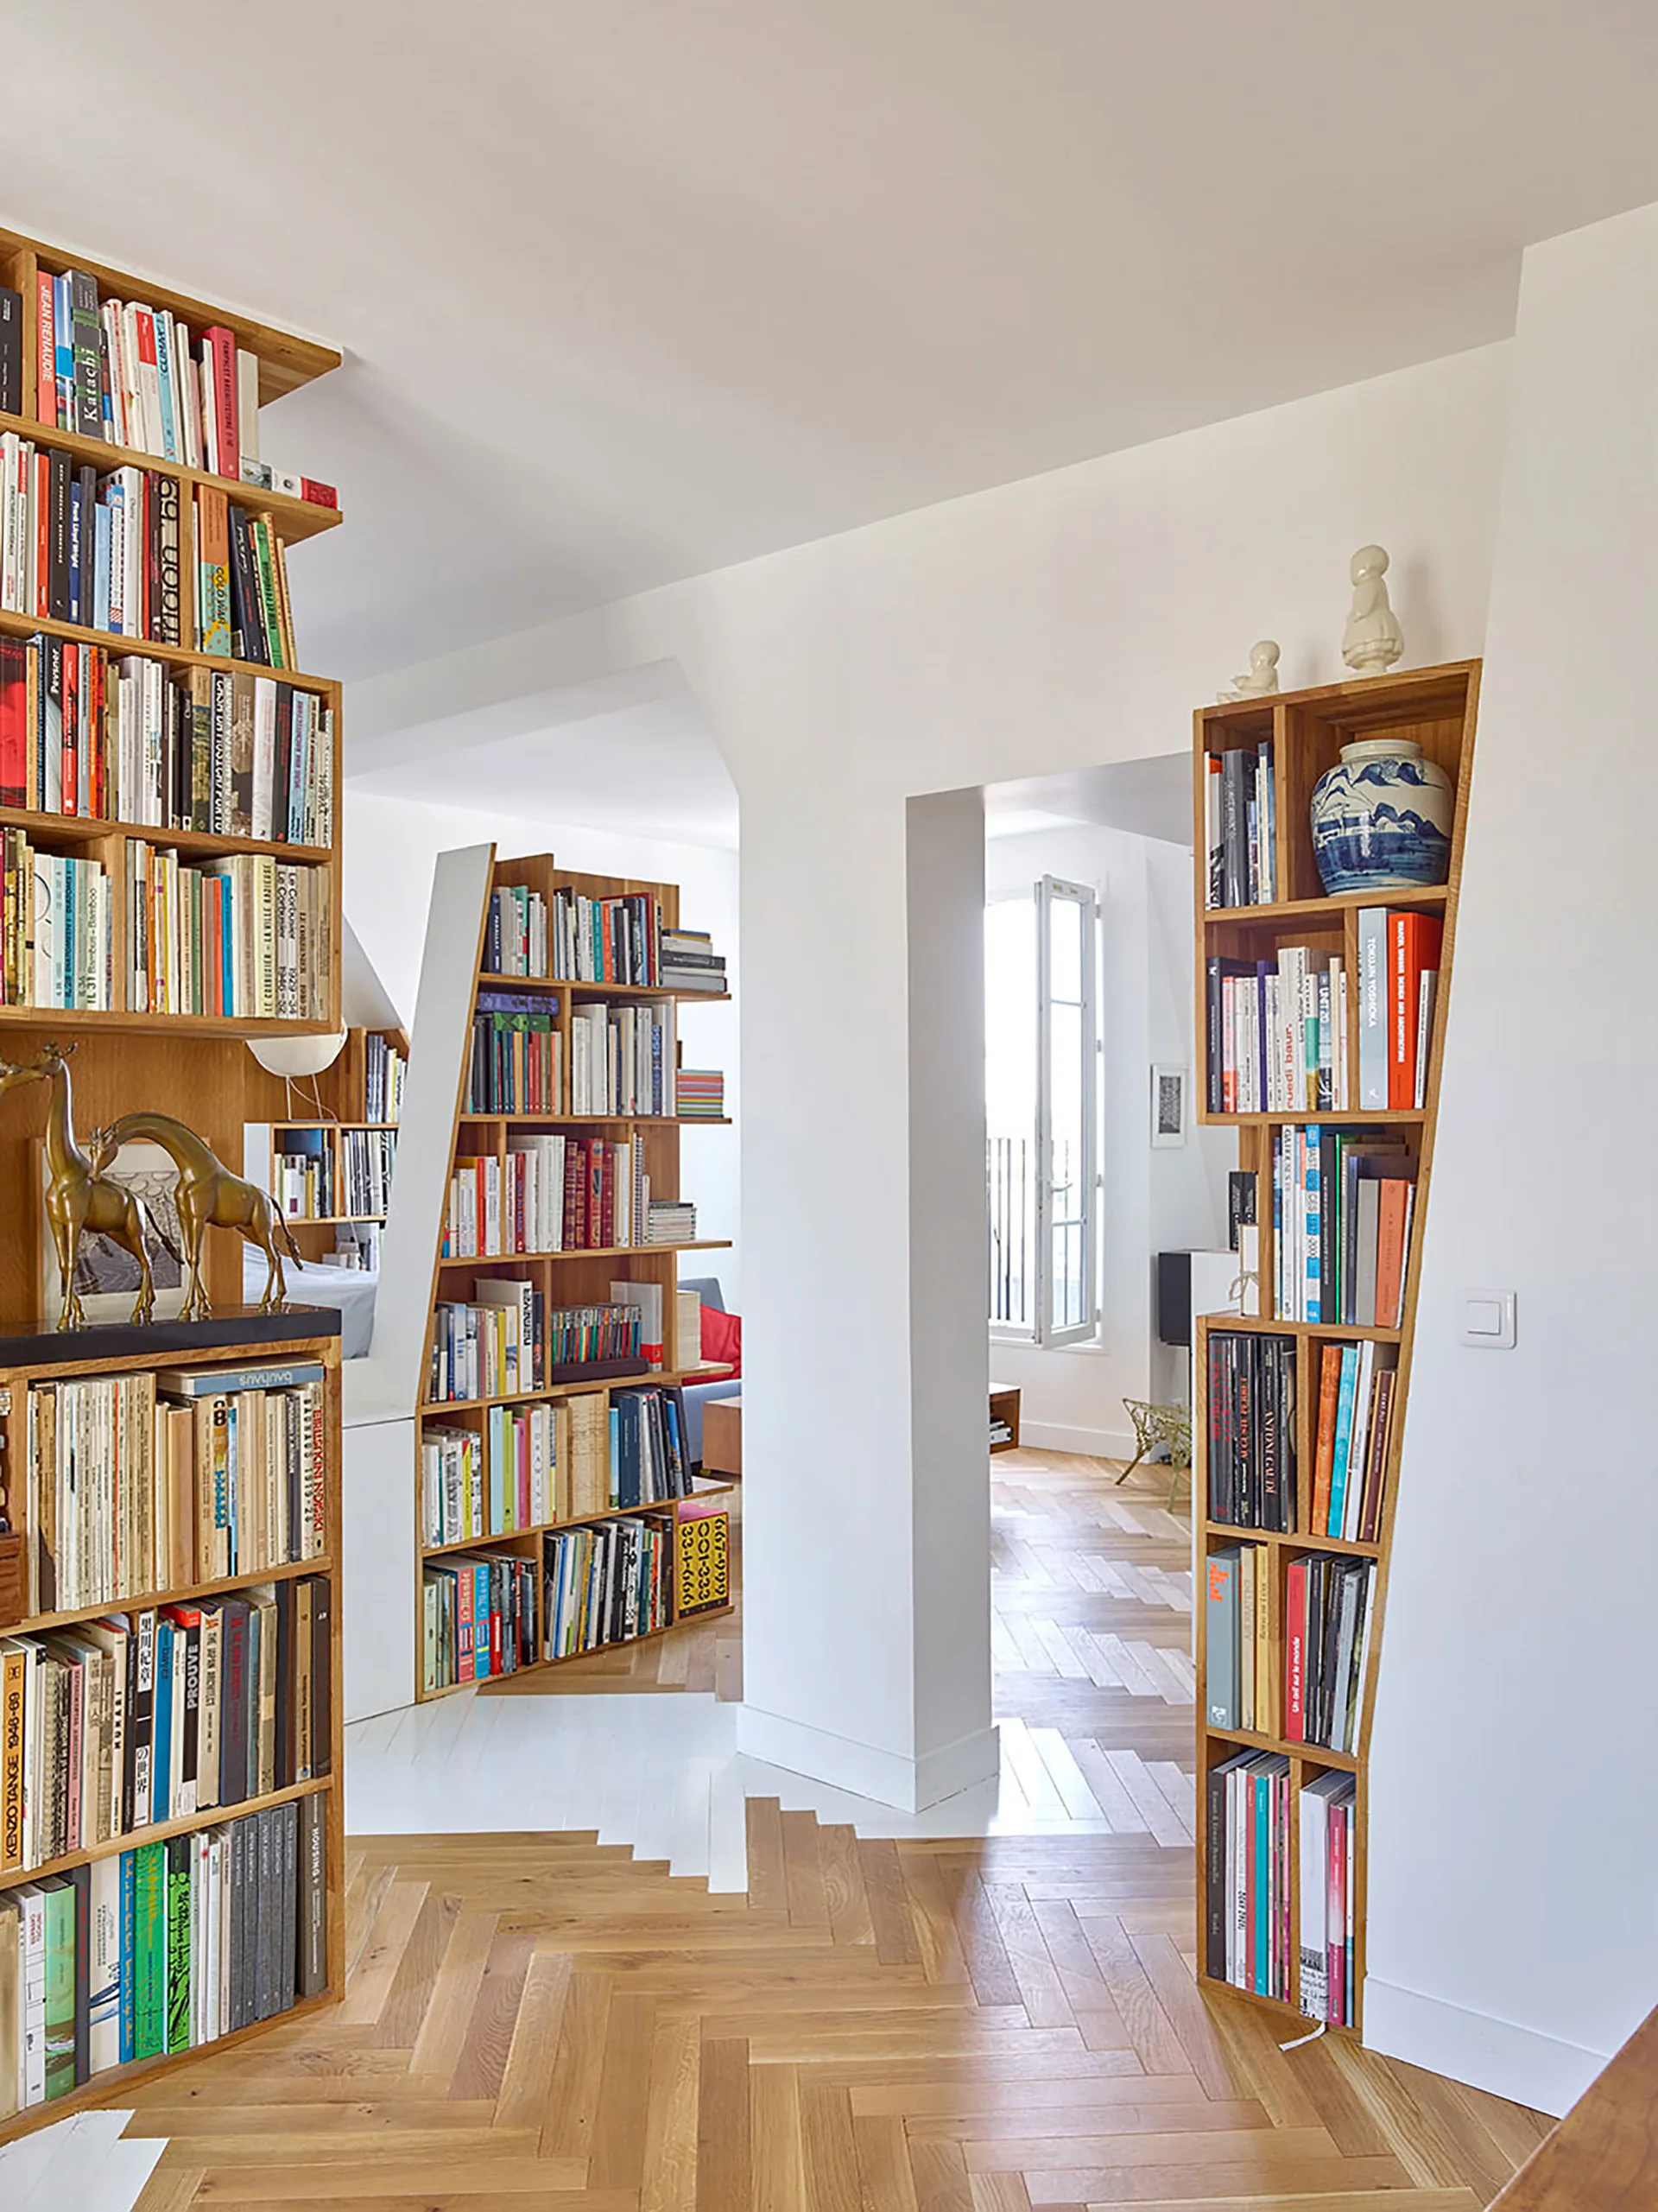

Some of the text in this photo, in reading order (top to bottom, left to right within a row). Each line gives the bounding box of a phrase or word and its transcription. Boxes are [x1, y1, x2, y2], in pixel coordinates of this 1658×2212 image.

[41, 285, 54, 382] JEAN RENAUDIE
[82, 348, 98, 422] Katachi
[215, 566, 227, 625] COLD WAR
[50, 649, 60, 694] Pevsner
[278, 871, 286, 886] Le
[288, 872, 296, 886] Le
[277, 887, 286, 939] Corbusier
[288, 888, 297, 940] Corbusier
[88, 936, 97, 973] Bambus
[1319, 987, 1329, 1010] UNIT
[1284, 1023, 1294, 1109] ruedi baur.
[238, 1372, 293, 1387] bauhaus
[1264, 1410, 1274, 1455] ANTONI
[187, 1643, 199, 1710] PROUVE
[6, 1755, 19, 1803] TANGE
[6, 1806, 18, 1858] KENZO
